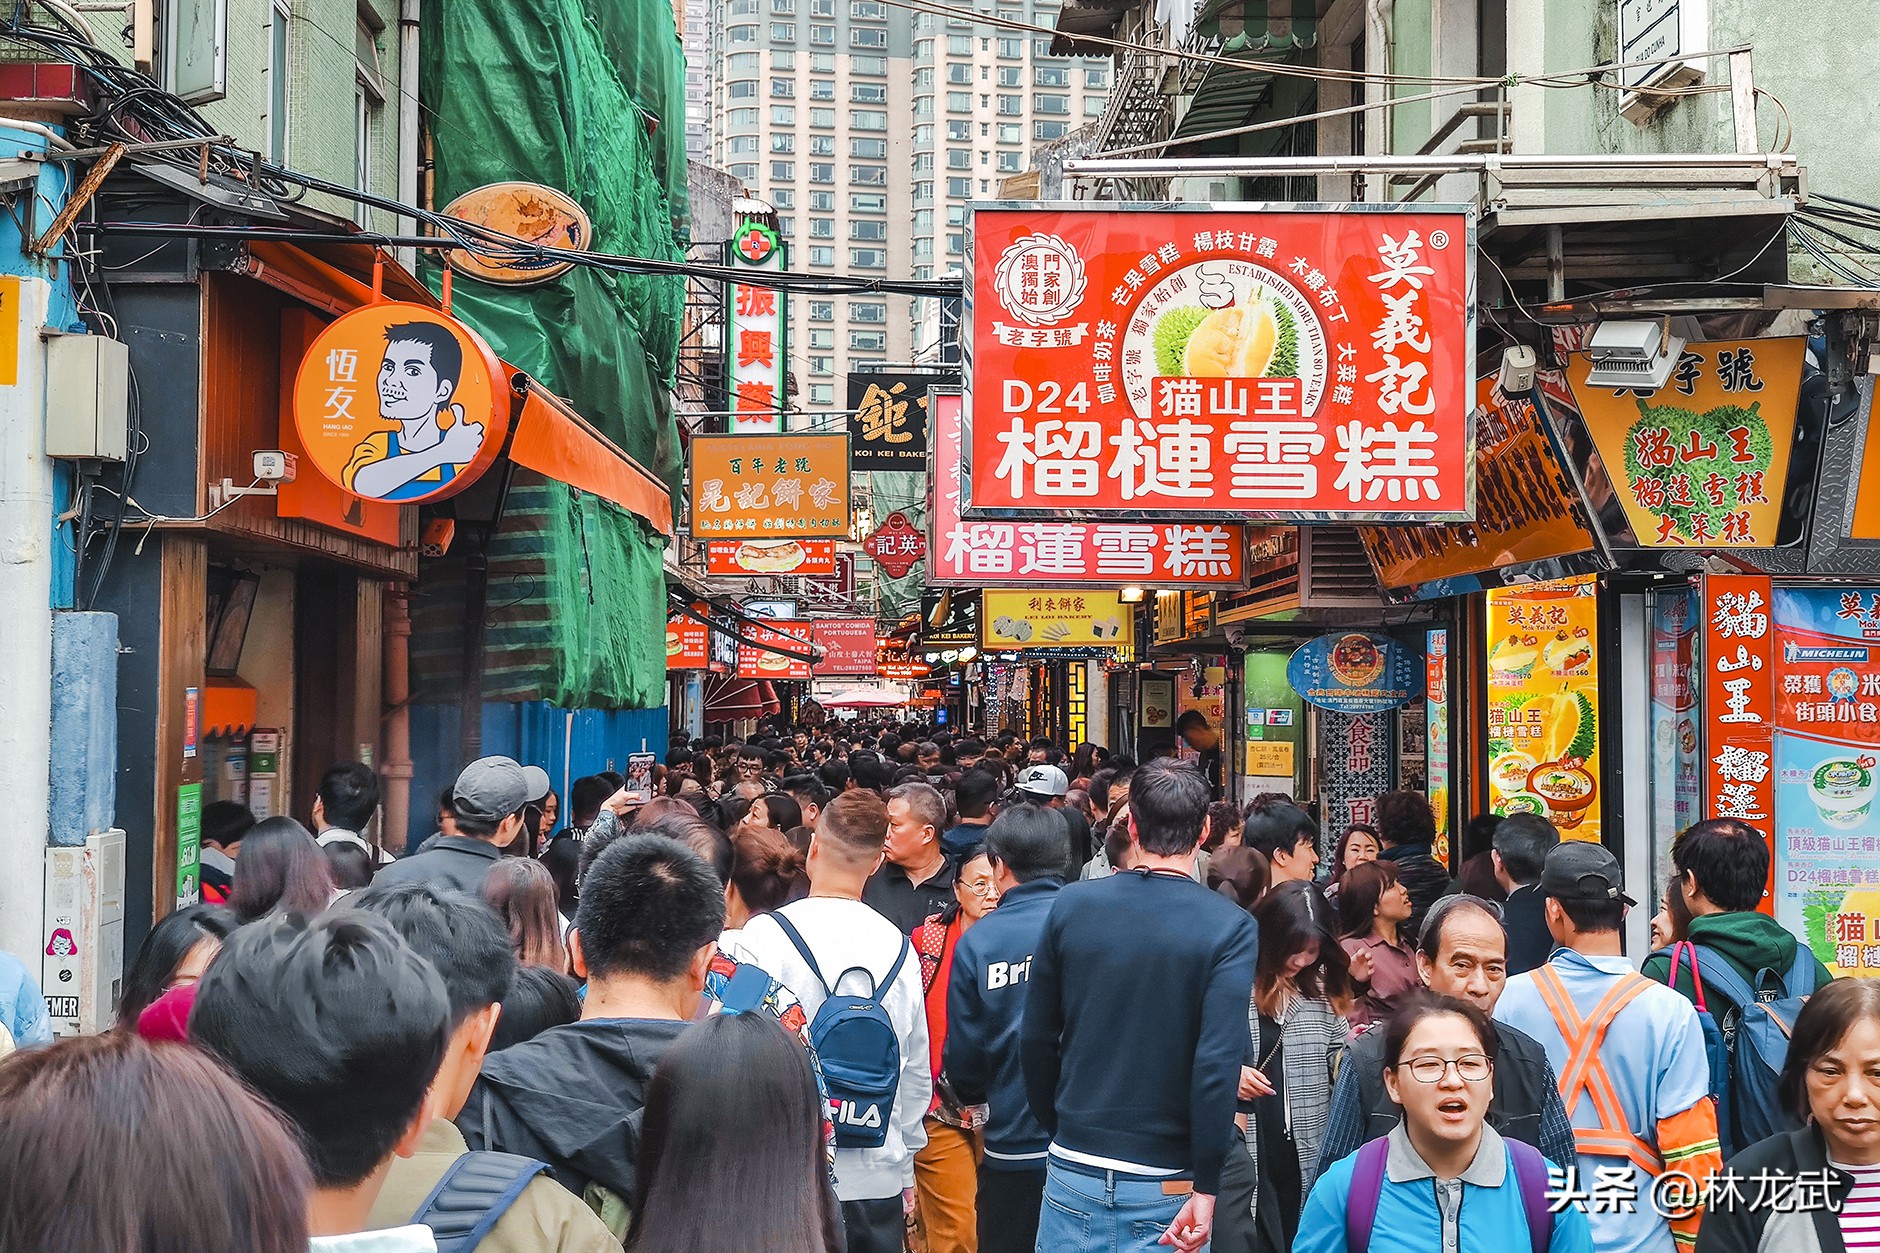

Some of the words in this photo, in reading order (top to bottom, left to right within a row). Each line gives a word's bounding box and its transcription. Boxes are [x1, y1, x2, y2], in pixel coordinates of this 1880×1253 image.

[1193, 230, 1278, 260] 楊枝甘露
[1021, 254, 1060, 270] 澳門
[1111, 242, 1181, 307] 芒果雪糕
[1021, 271, 1060, 288] 獨家
[1228, 264, 1295, 301] ESTABLISHED
[1021, 289, 1060, 305] 始創
[1292, 297, 1314, 326] MORE
[1007, 328, 1073, 346] 老字號
[1367, 229, 1437, 416] 莫義記
[1308, 325, 1323, 356] THAN
[1003, 380, 1092, 414] D24
[1158, 379, 1297, 416] 猫山王
[1303, 372, 1323, 407] YEARS
[995, 418, 1442, 502] 榴槤雪糕
[1634, 427, 1757, 469] 貓山王
[1632, 470, 1768, 507] 榴蓮雪糕
[1655, 511, 1757, 545] 大菜糕
[944, 523, 1232, 577] 榴蓮雪糕
[1028, 596, 1086, 612] 利來餅家
[1507, 605, 1568, 625] 莫義記
[1711, 590, 1768, 724] 貓山王
[1801, 650, 1865, 658] MICHELIN
[1784, 675, 1822, 695] 榮獲
[1490, 708, 1542, 723] 猫山王
[1795, 702, 1878, 723] 街頭小食
[1787, 836, 1880, 851] 頂級猫山王榴
[1836, 912, 1880, 941] 猫
[986, 953, 1034, 992] Bri
[826, 1098, 881, 1128] FILA
